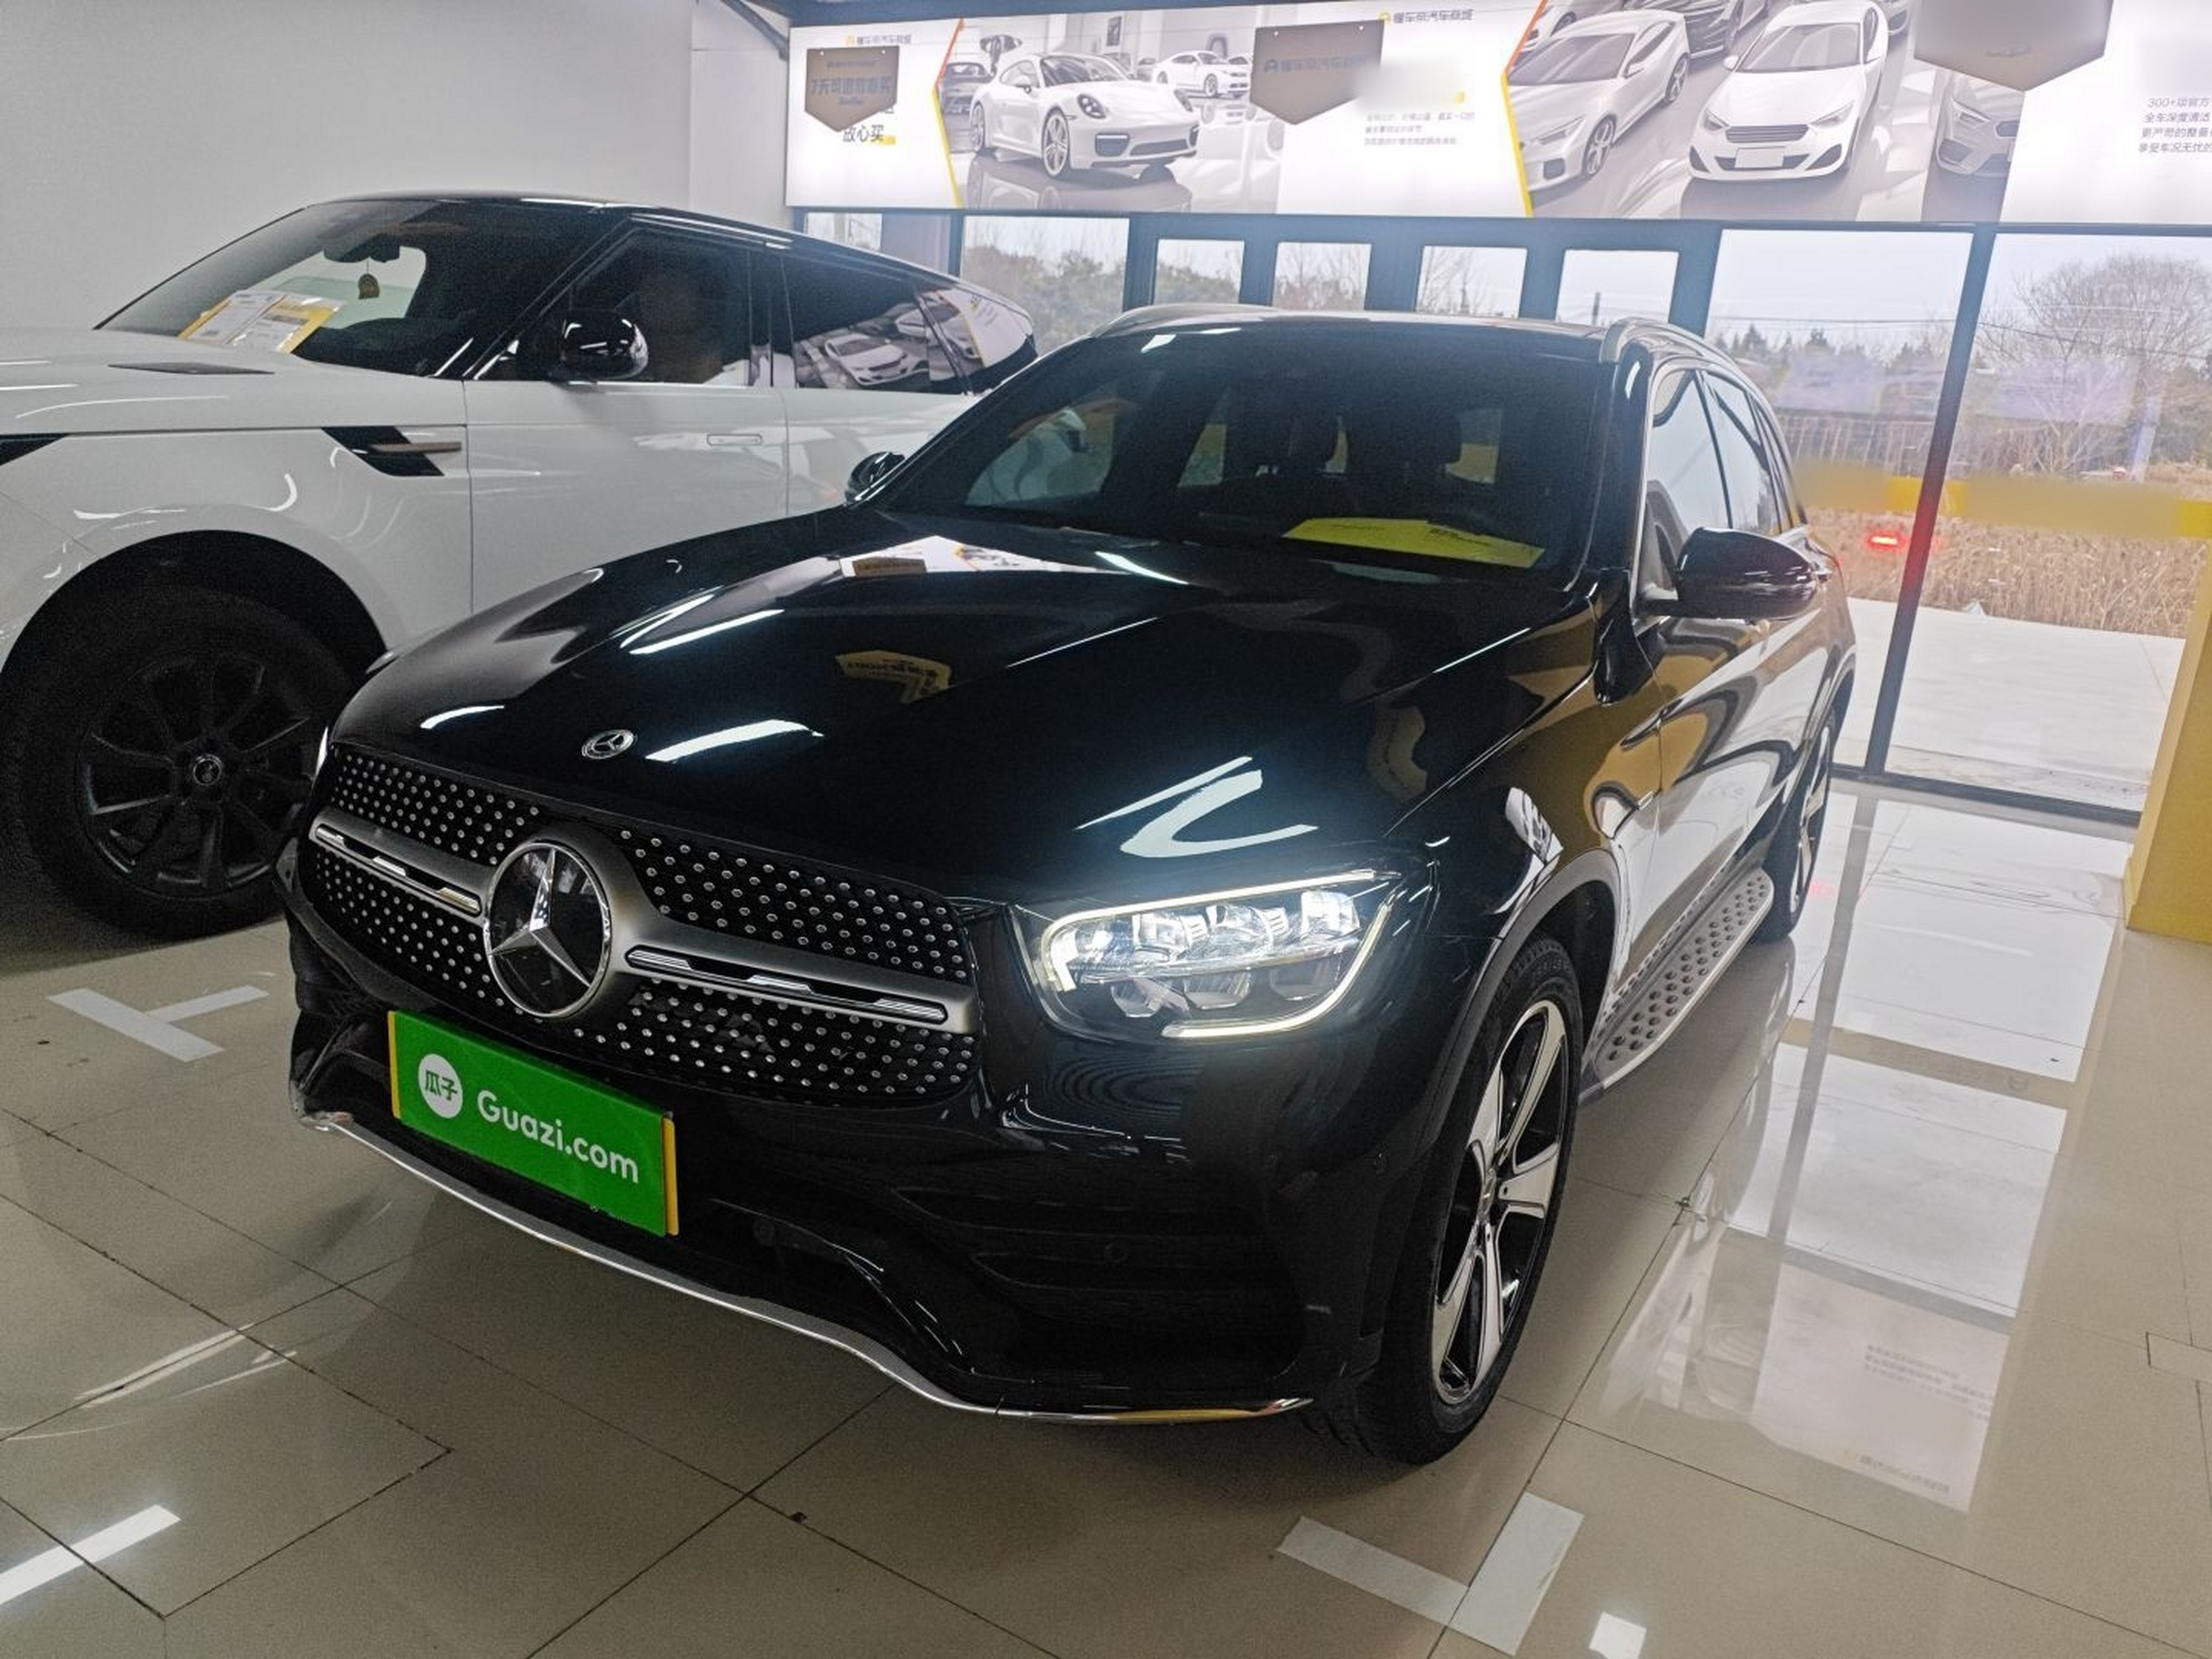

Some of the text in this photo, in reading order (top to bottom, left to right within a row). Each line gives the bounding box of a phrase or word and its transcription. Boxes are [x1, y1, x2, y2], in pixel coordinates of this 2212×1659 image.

[843, 124, 884, 142] 放心买
[2142, 127, 2212, 138] 更严苛的整备
[425, 1069, 458, 1101] 瓜子
[477, 1090, 639, 1184] Guazi.com
